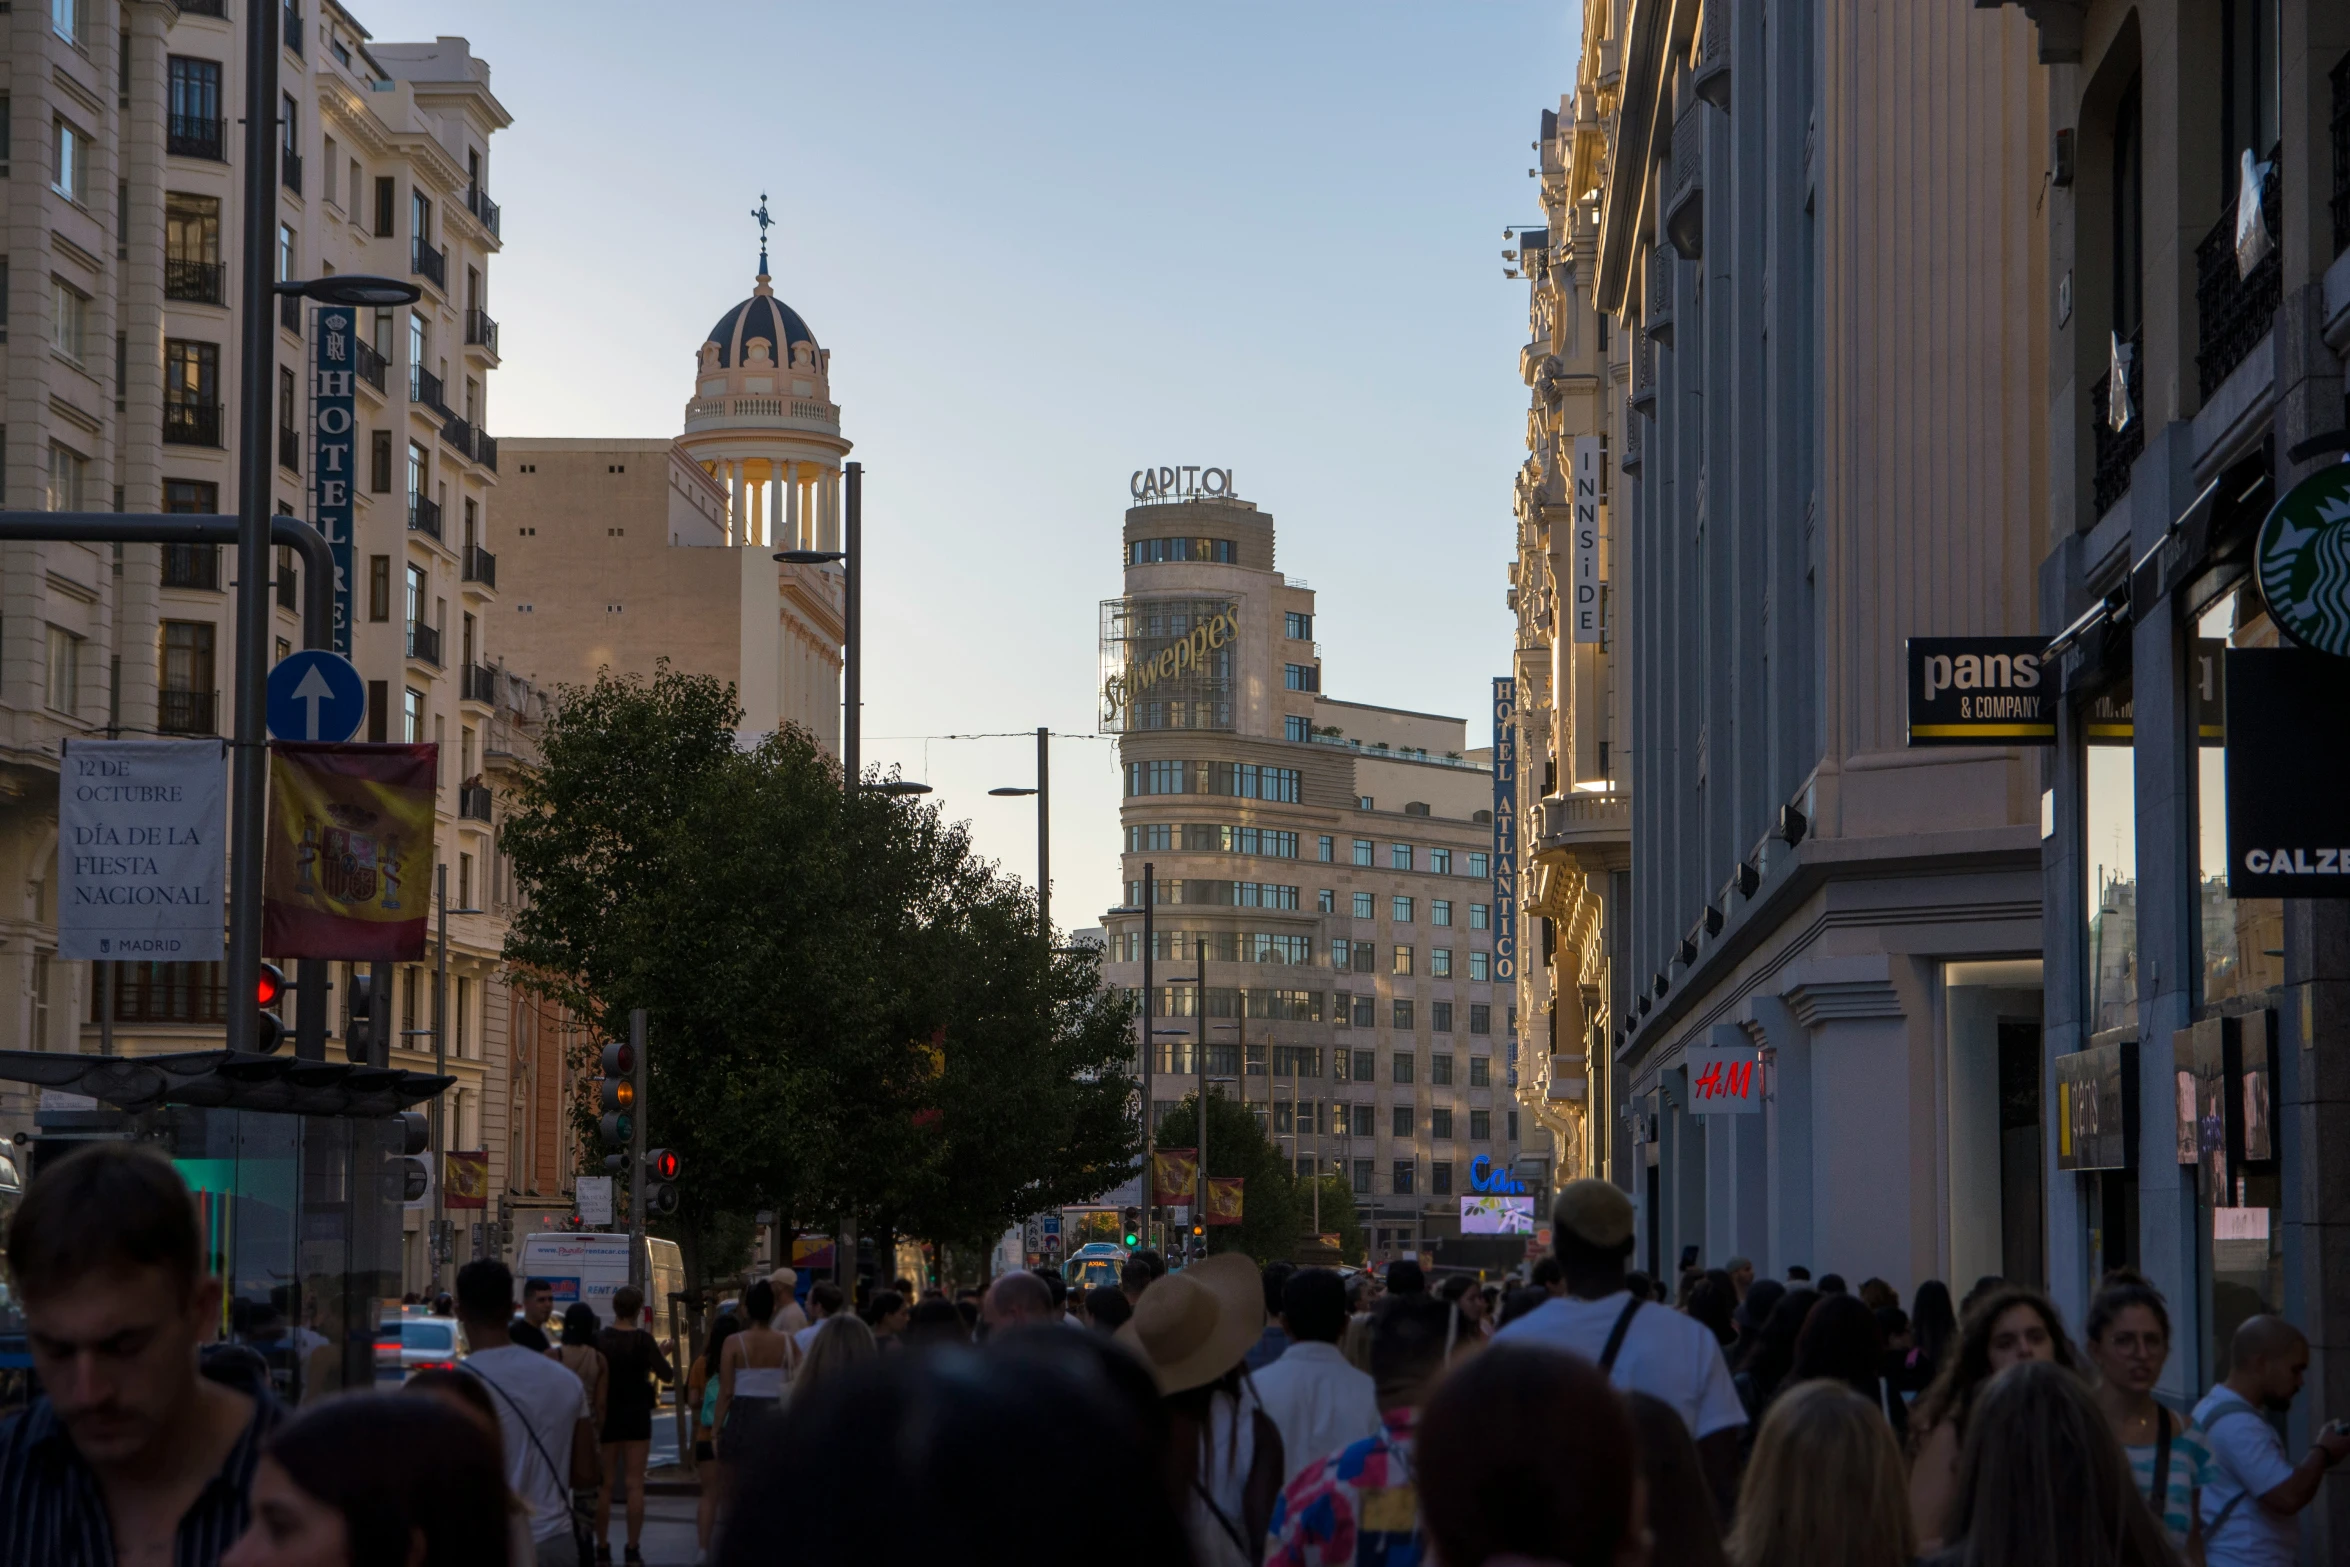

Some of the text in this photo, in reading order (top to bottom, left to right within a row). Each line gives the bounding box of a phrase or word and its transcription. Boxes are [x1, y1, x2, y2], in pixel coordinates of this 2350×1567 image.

[318, 369, 353, 544] HOTEL
[1131, 465, 1238, 498] CAPITOL
[1104, 603, 1240, 723] Schweppes
[1924, 653, 2041, 702] pans
[1961, 696, 2041, 719] & COMPANY
[79, 760, 130, 777] 12 DE
[76, 785, 182, 802] OCTUBRE
[75, 823, 201, 845] DÍA DE LA
[1496, 682, 1514, 977] HOTEL ATLANTICO
[75, 856, 158, 875] FIESTA
[74, 886, 210, 905] NACIONAL
[119, 940, 181, 951] MADRID
[1695, 1060, 1753, 1100] H&M
[2073, 1078, 2099, 1156] pans
[1087, 1260, 1108, 1268] AXIAL
[587, 1286, 611, 1294] RENT
